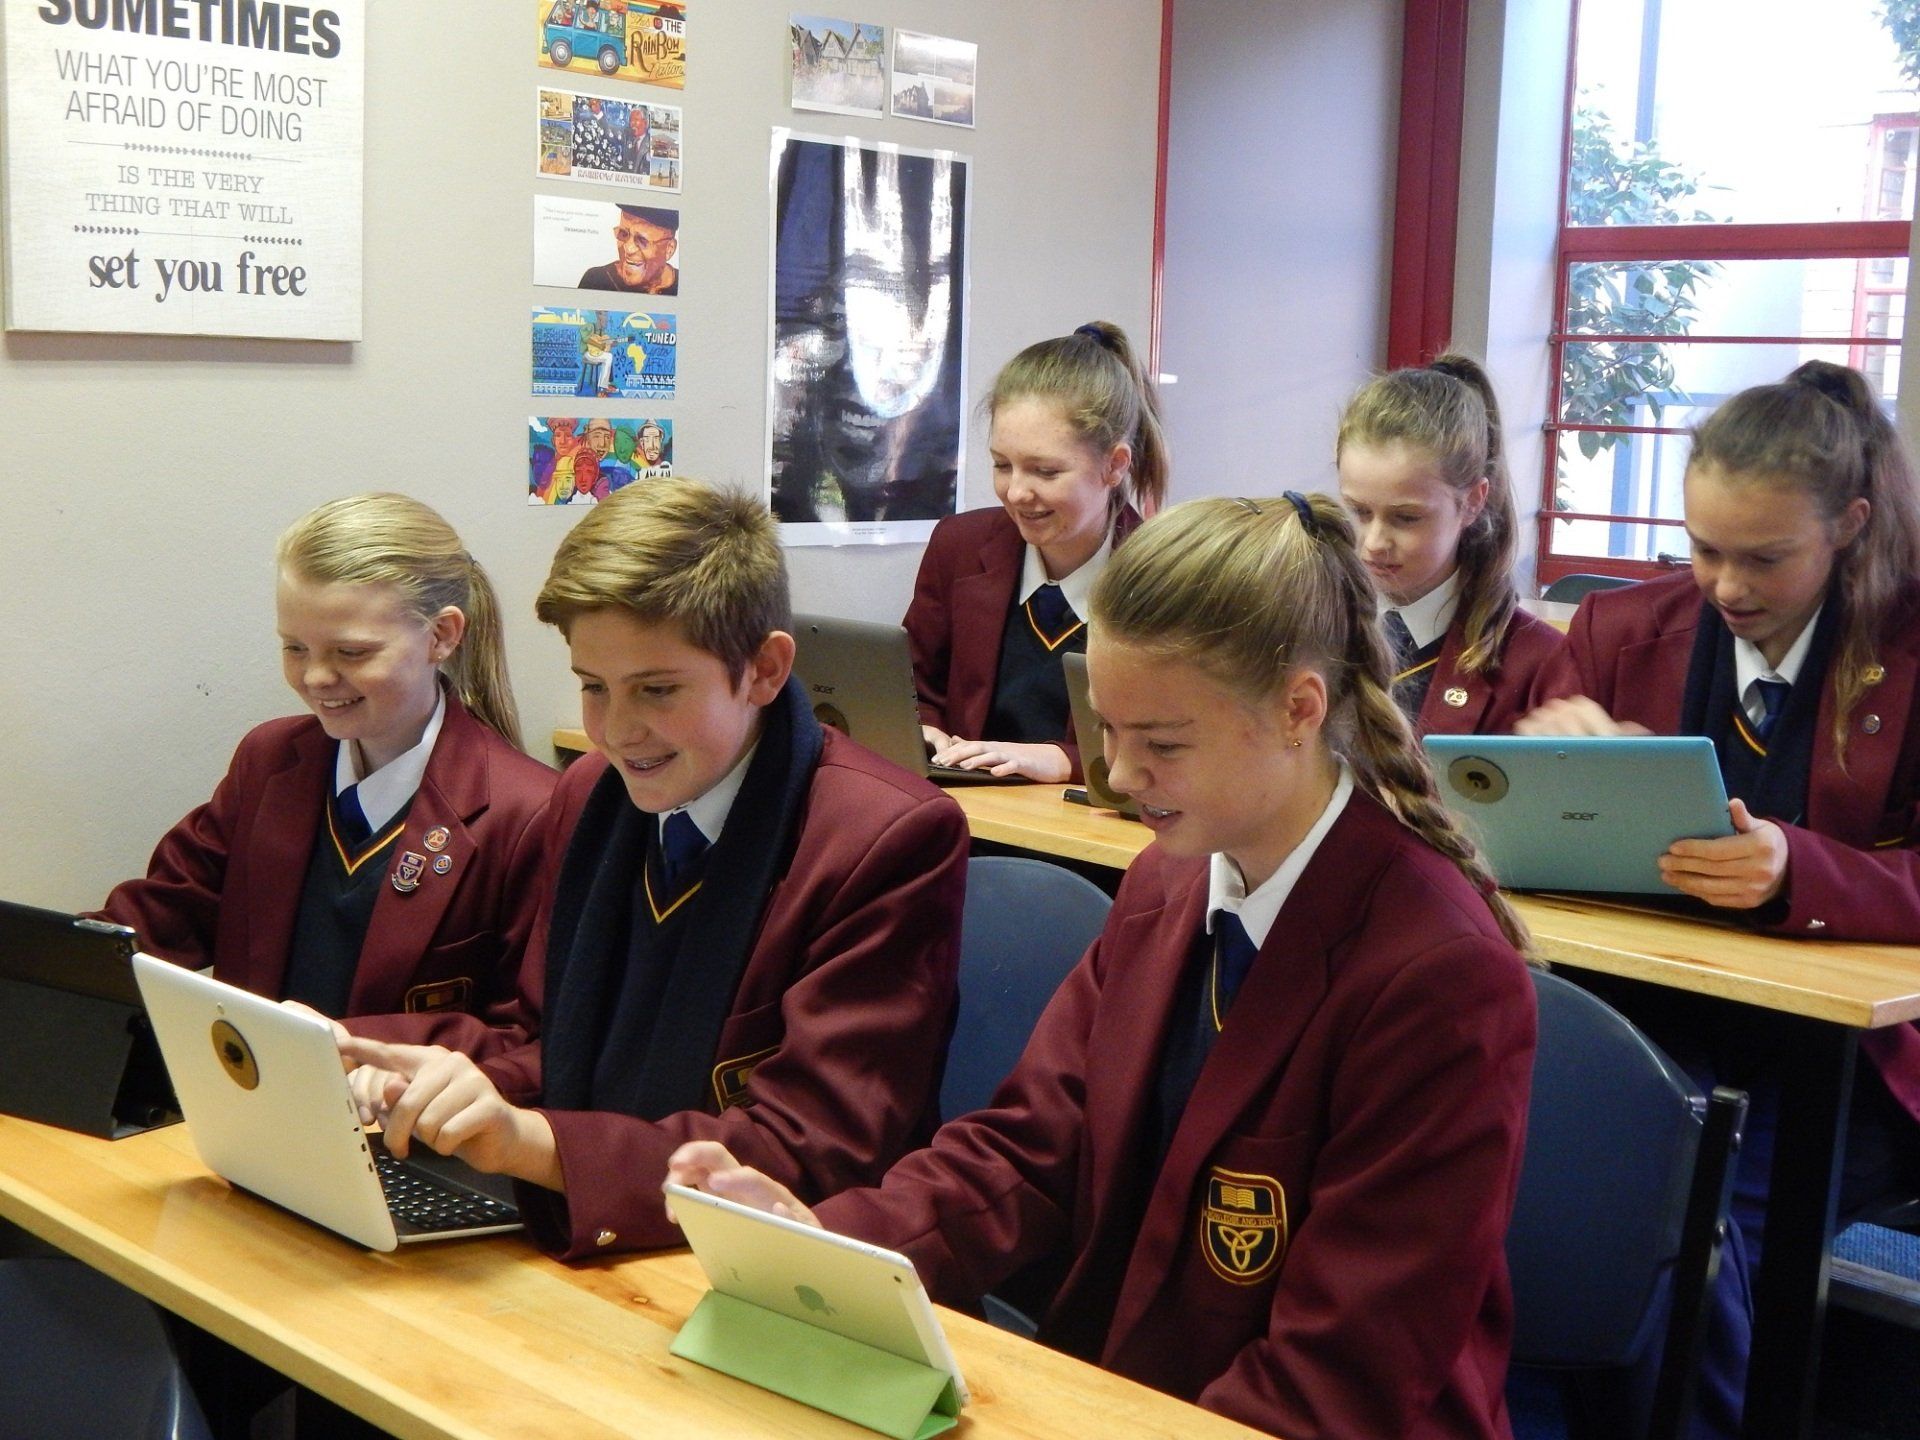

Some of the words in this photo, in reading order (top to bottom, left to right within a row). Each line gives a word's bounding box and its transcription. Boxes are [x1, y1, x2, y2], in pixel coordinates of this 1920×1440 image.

[665, 19, 682, 33] THE
[55, 49, 138, 87] WHAT
[145, 58, 245, 99] YOU'RE
[254, 71, 329, 108] MOST
[65, 90, 166, 129] AFRAID
[177, 100, 212, 133] OF
[221, 105, 303, 142] DOING
[118, 165, 140, 184] IS
[148, 168, 195, 188] THE
[202, 171, 264, 194] VERY
[85, 193, 161, 216] THING
[169, 198, 230, 220] THAT
[238, 203, 294, 225] WILL
[89, 249, 140, 289] set
[154, 257, 224, 303] you
[236, 251, 307, 297] free
[645, 332, 676, 345] TUNED
[812, 684, 835, 694] acer
[1561, 811, 1599, 821] acer
[1242, 1216, 1257, 1226] AND
